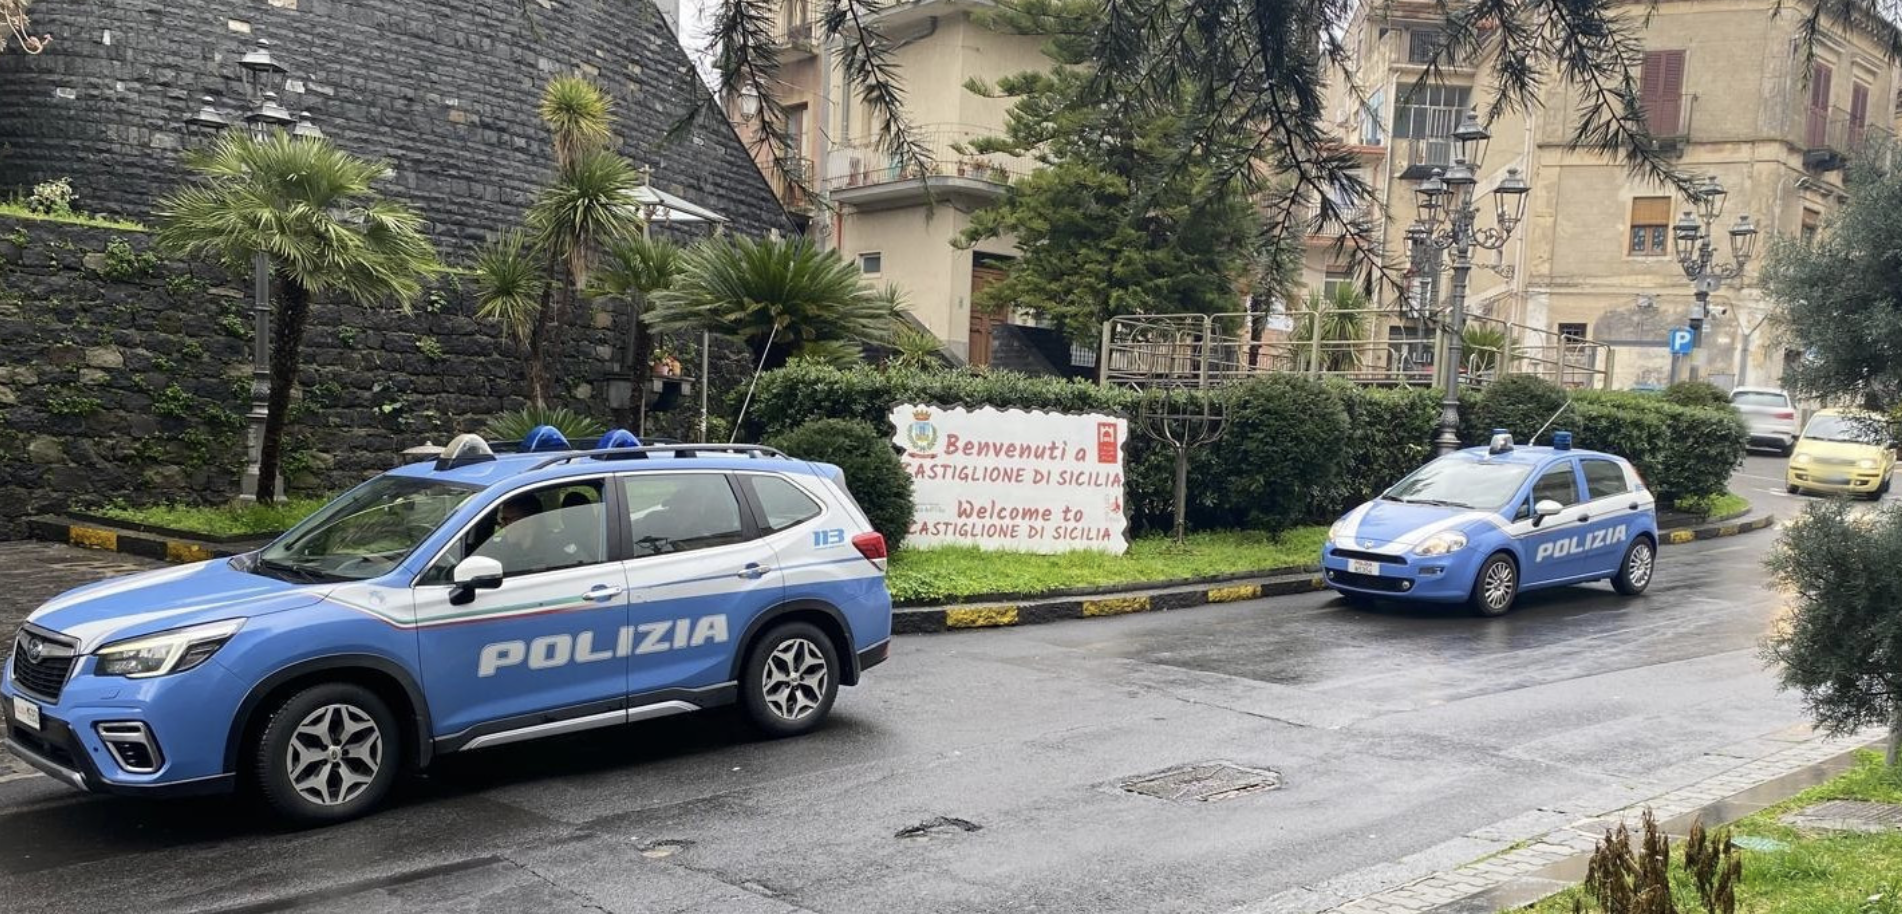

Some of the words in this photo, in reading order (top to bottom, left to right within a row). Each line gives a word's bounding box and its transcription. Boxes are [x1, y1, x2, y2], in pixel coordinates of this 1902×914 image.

[1675, 331, 1691, 350] P
[944, 433, 1068, 461] Benvenuti
[1074, 447, 1087, 462] a
[1032, 468, 1051, 485] DI
[1056, 469, 1122, 488] SICILIA
[957, 499, 1052, 522] Welcome
[1062, 505, 1084, 522] to
[812, 528, 845, 547] 113
[1028, 524, 1044, 539] DI
[1052, 525, 1112, 541] SICILIA
[1535, 524, 1627, 562] POLIZIA
[477, 613, 730, 678] POLIZIA
